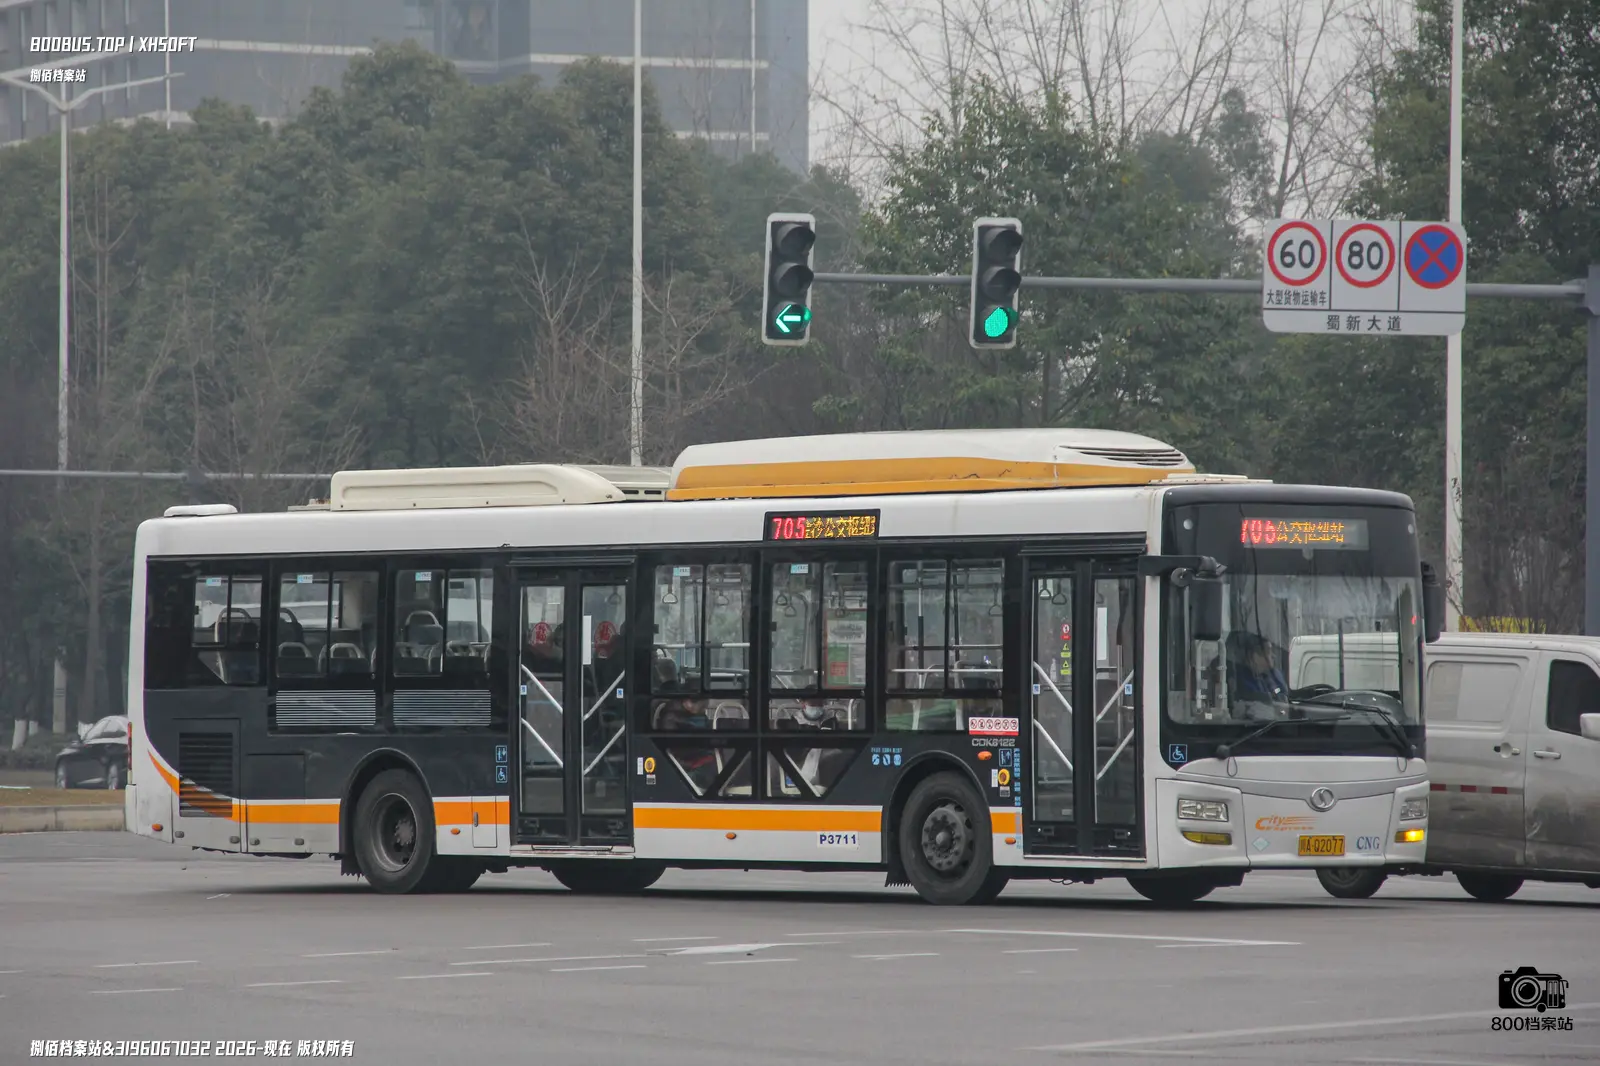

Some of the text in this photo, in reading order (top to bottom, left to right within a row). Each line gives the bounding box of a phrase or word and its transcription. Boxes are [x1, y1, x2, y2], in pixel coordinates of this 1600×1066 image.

[1279, 239, 1316, 269] 60
[1347, 240, 1384, 270] 80
[1266, 289, 1328, 306] 大型货物运输车
[1326, 314, 1402, 332] 蜀新大道
[772, 516, 806, 540] 705
[1255, 815, 1286, 830] City
[819, 834, 857, 845] P3711
[1356, 836, 1379, 850] CNG
